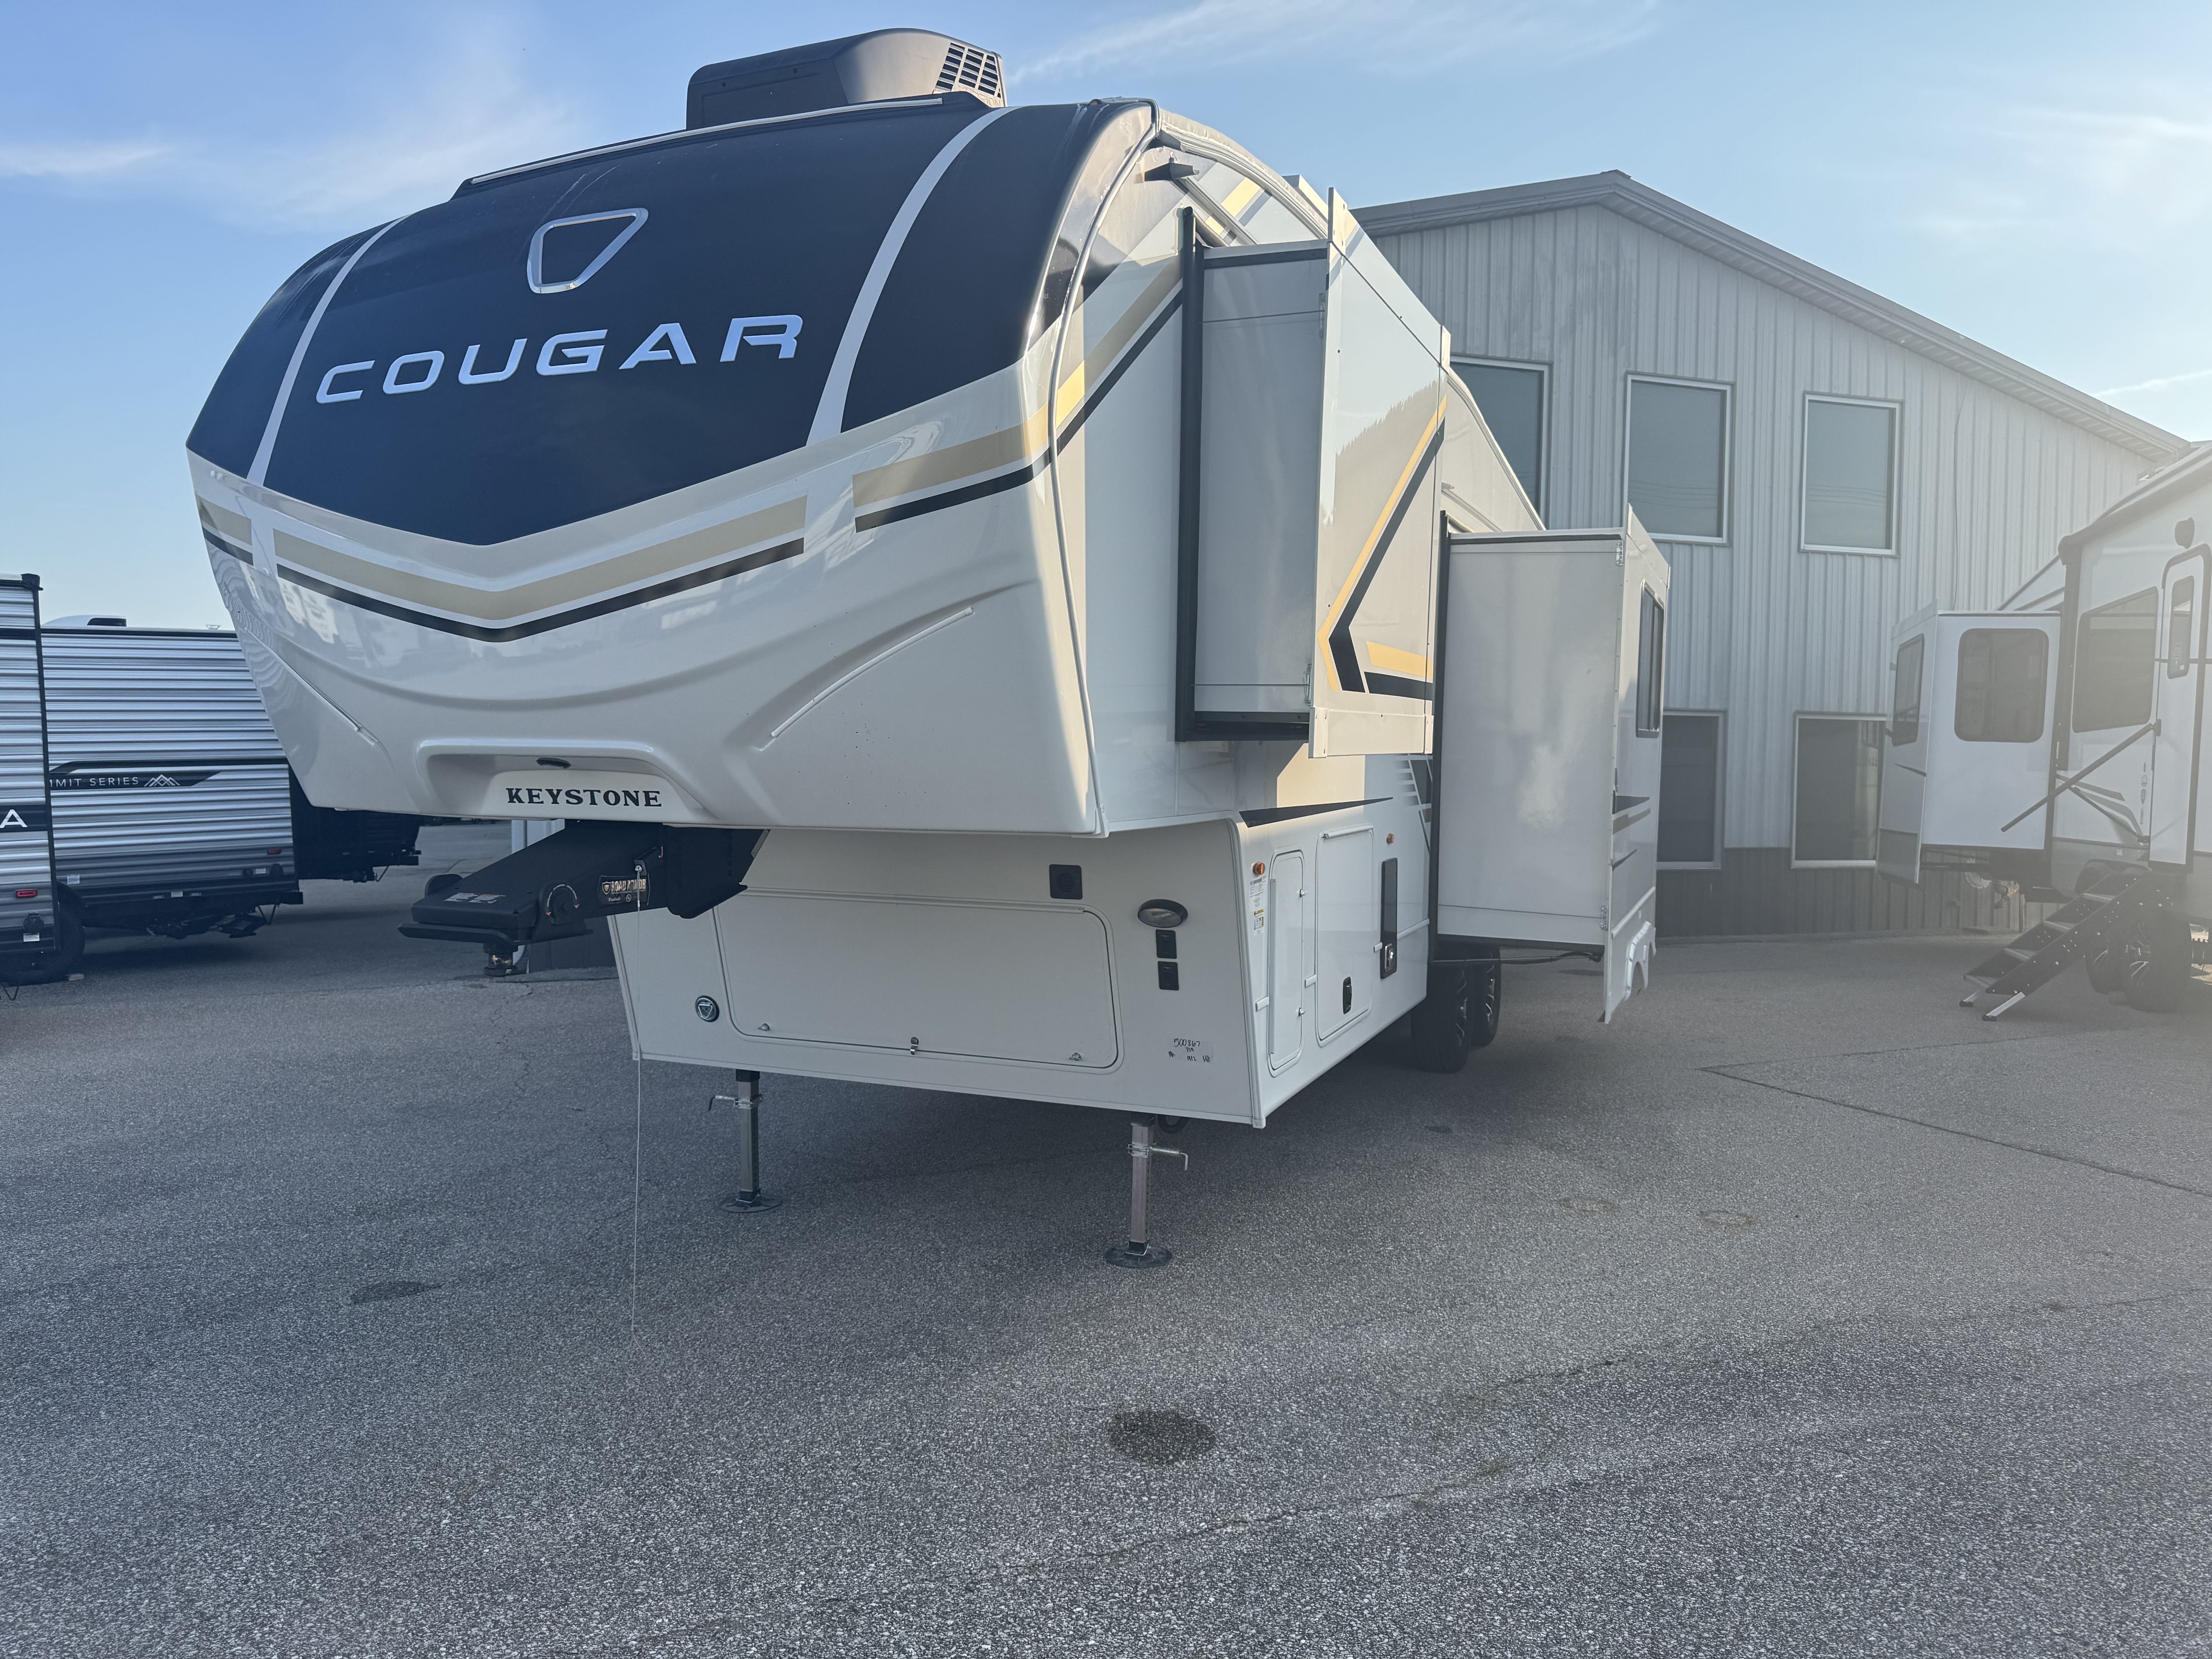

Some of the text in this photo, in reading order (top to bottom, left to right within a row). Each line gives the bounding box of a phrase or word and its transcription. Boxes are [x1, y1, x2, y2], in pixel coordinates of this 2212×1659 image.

[316, 314, 803, 404] COUGAR
[89, 776, 139, 787] SERIES
[506, 788, 662, 807] KEYSTONE
[0, 809, 27, 828] A
[611, 880, 626, 892] ROAD
[1174, 1039, 1200, 1047] 500867
